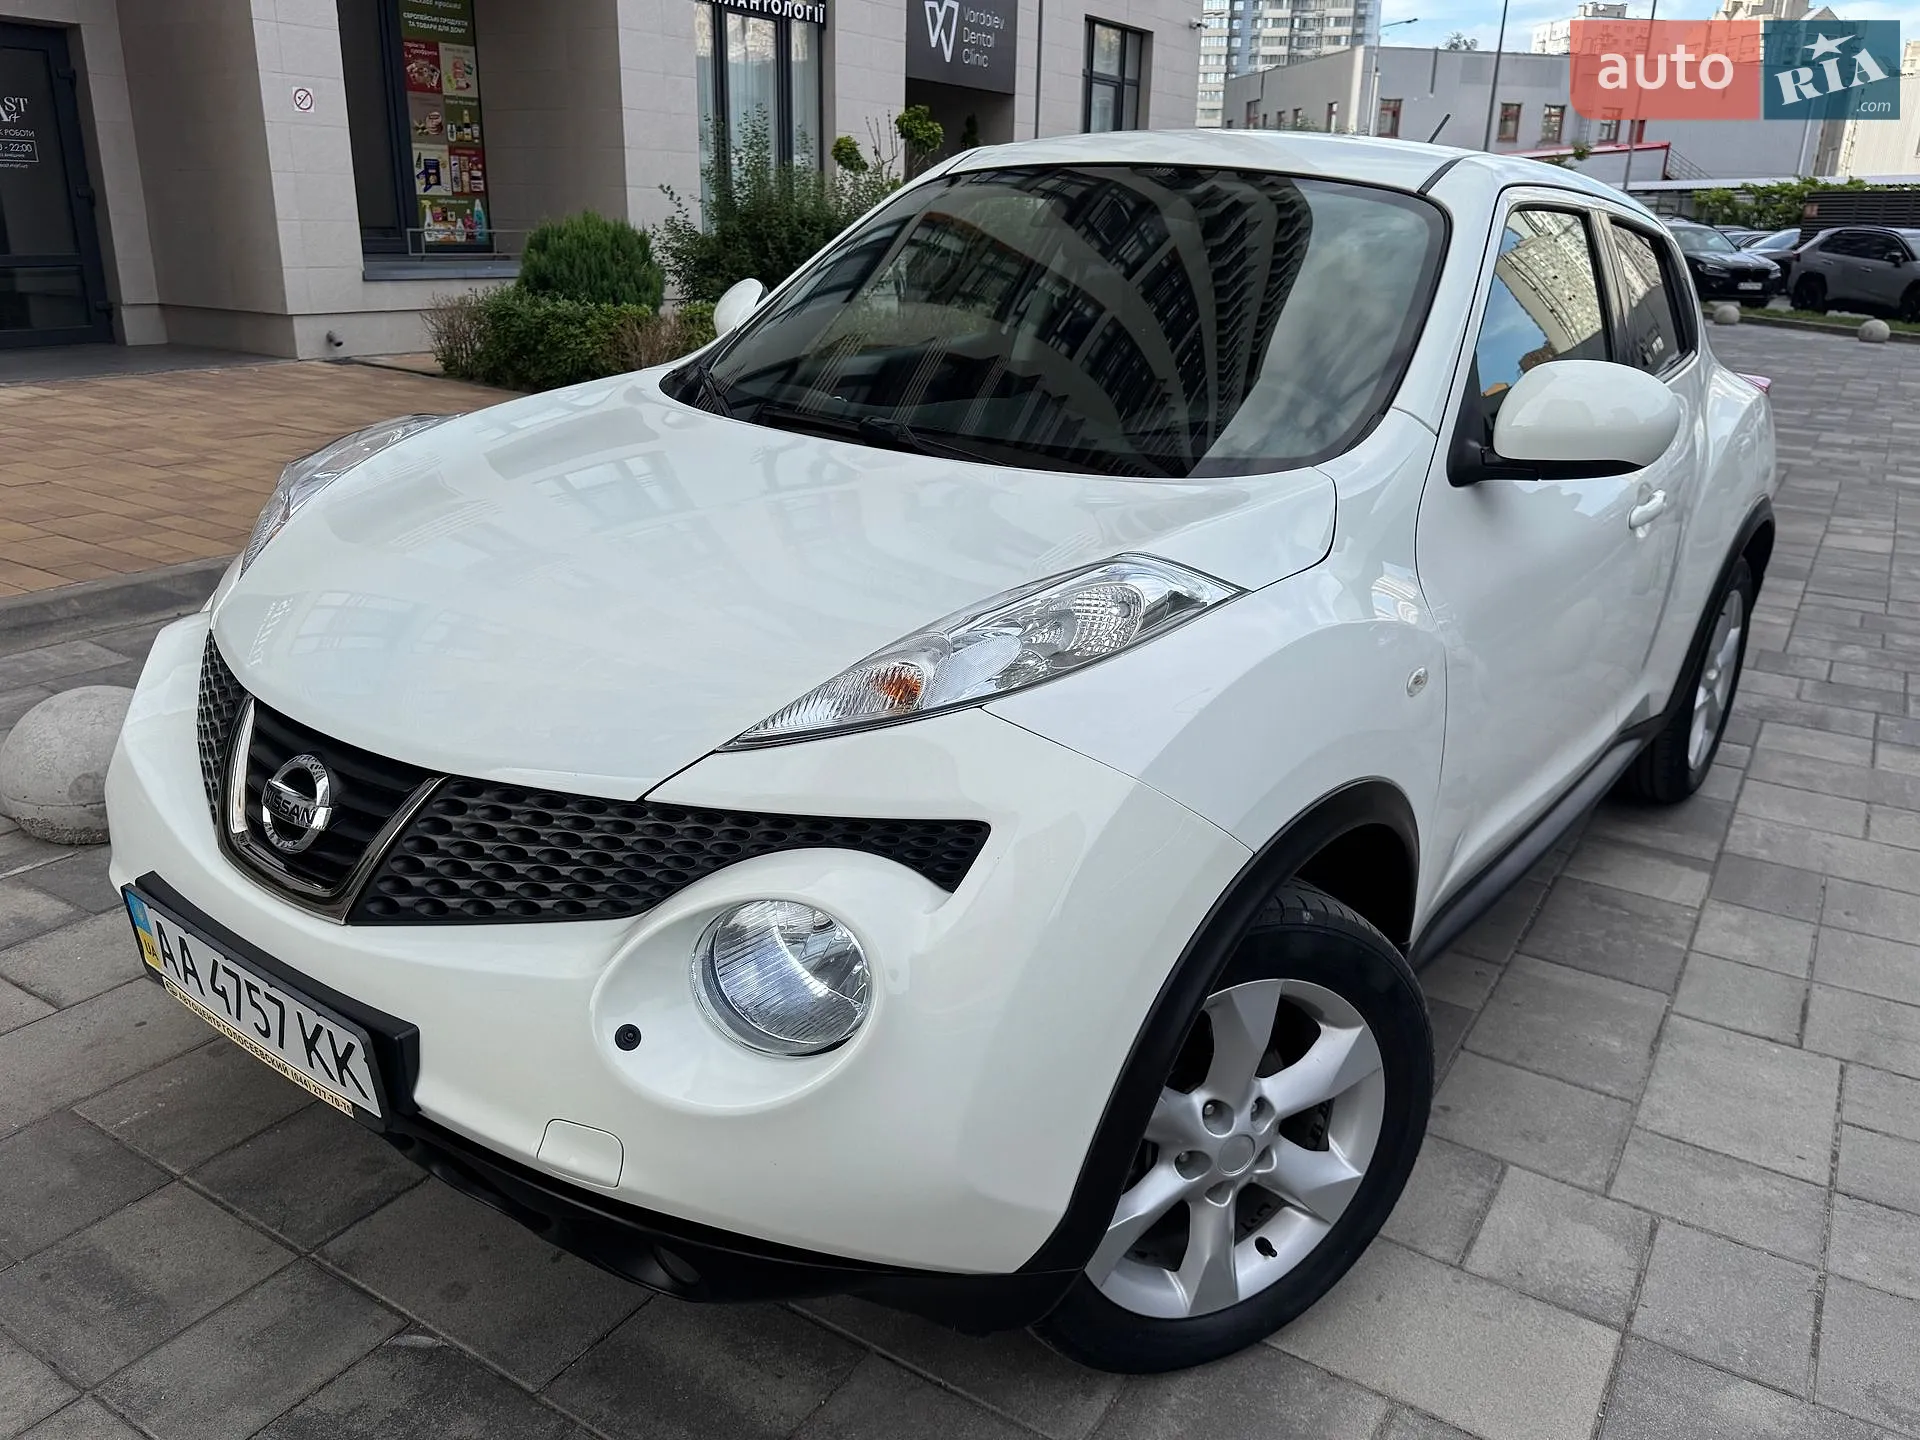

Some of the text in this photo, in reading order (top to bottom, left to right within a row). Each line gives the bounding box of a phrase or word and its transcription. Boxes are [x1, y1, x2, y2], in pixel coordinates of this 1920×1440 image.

[416, 21, 438, 30] ТОВАРИ
[438, 24, 450, 32] ДЛЯ
[450, 26, 467, 34] ДОМУ
[440, 17, 468, 27] ПРОДУКТИ
[962, 26, 995, 48] Dental
[962, 48, 989, 68] Clinic
[4, 128, 35, 138] РОБОТИ
[9, 143, 33, 153] 22:00
[143, 940, 160, 962] UA
[155, 920, 371, 1101] AA 4757 KK
[178, 992, 222, 1029] АВТОЦЕНТР
[291, 1069, 312, 1091] (044)
